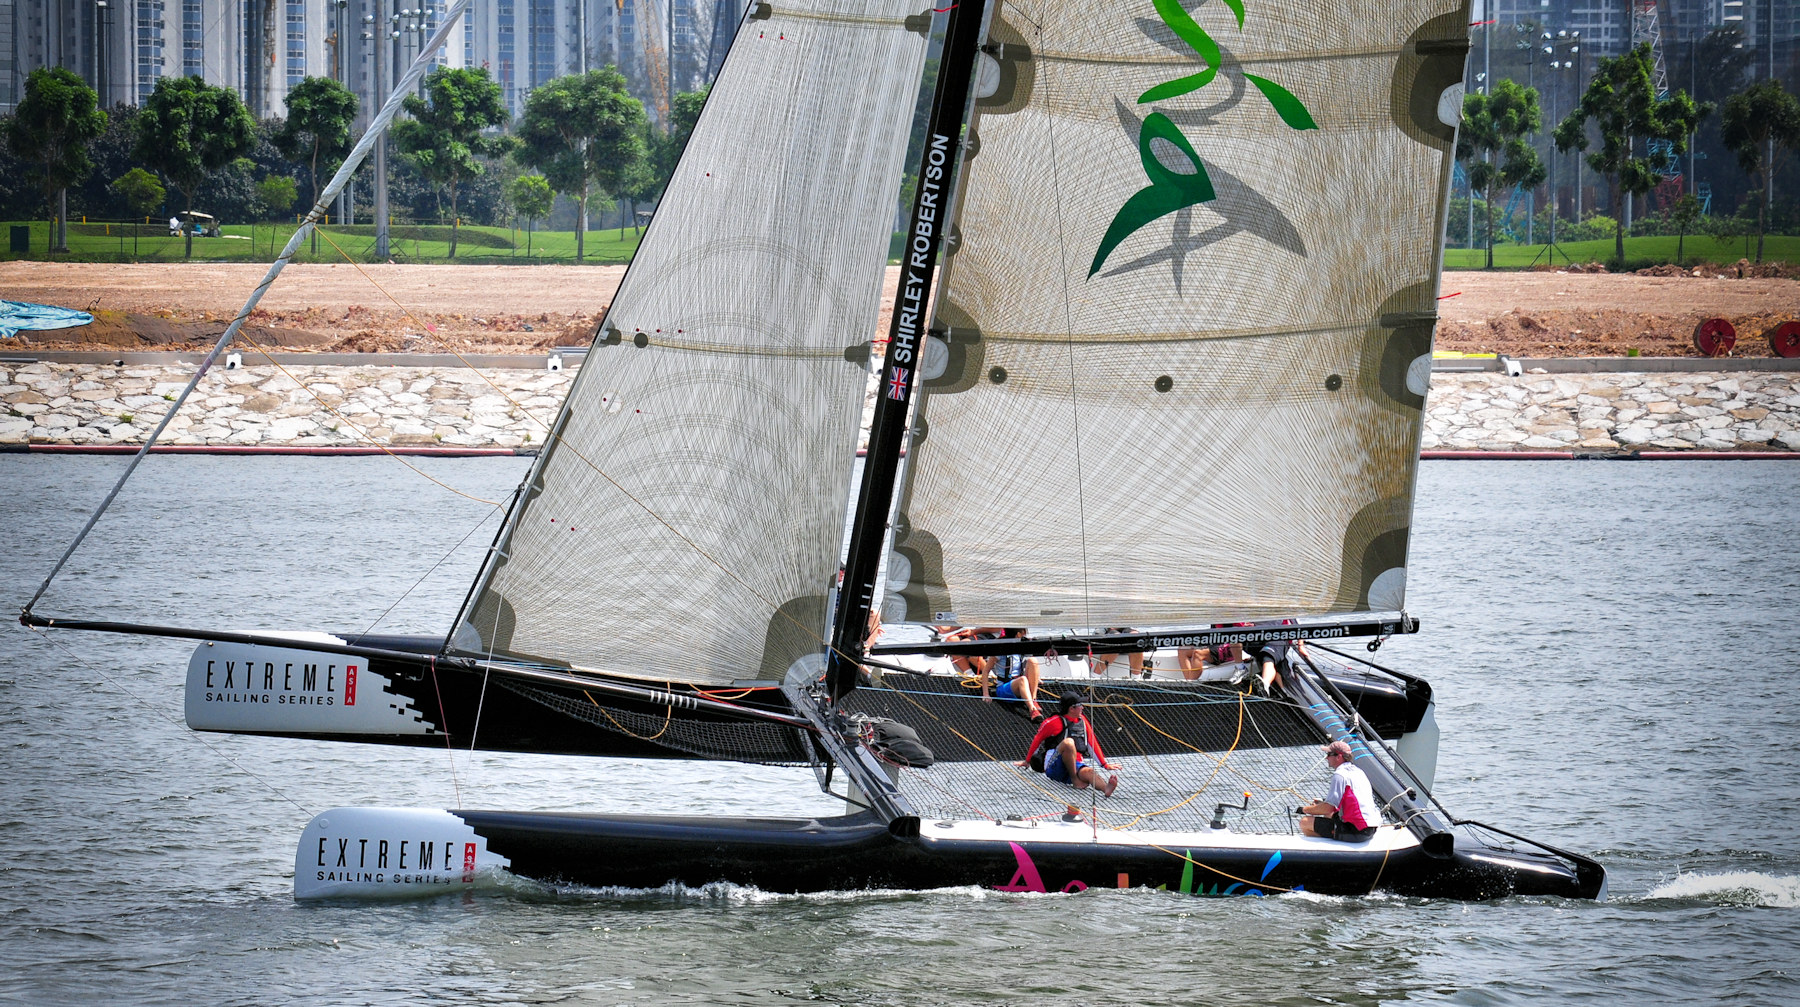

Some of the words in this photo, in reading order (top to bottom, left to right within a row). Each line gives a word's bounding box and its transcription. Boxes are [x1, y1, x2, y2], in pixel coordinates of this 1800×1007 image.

[894, 271, 924, 364] SHIRLEY
[911, 133, 950, 269] ROBERTSON
[206, 660, 336, 691] EXTREME
[346, 668, 354, 704] ASIA
[205, 692, 269, 704] SAILING
[278, 695, 334, 706] SERIES
[317, 837, 454, 871] EXTREME
[316, 871, 384, 883] SAILING
